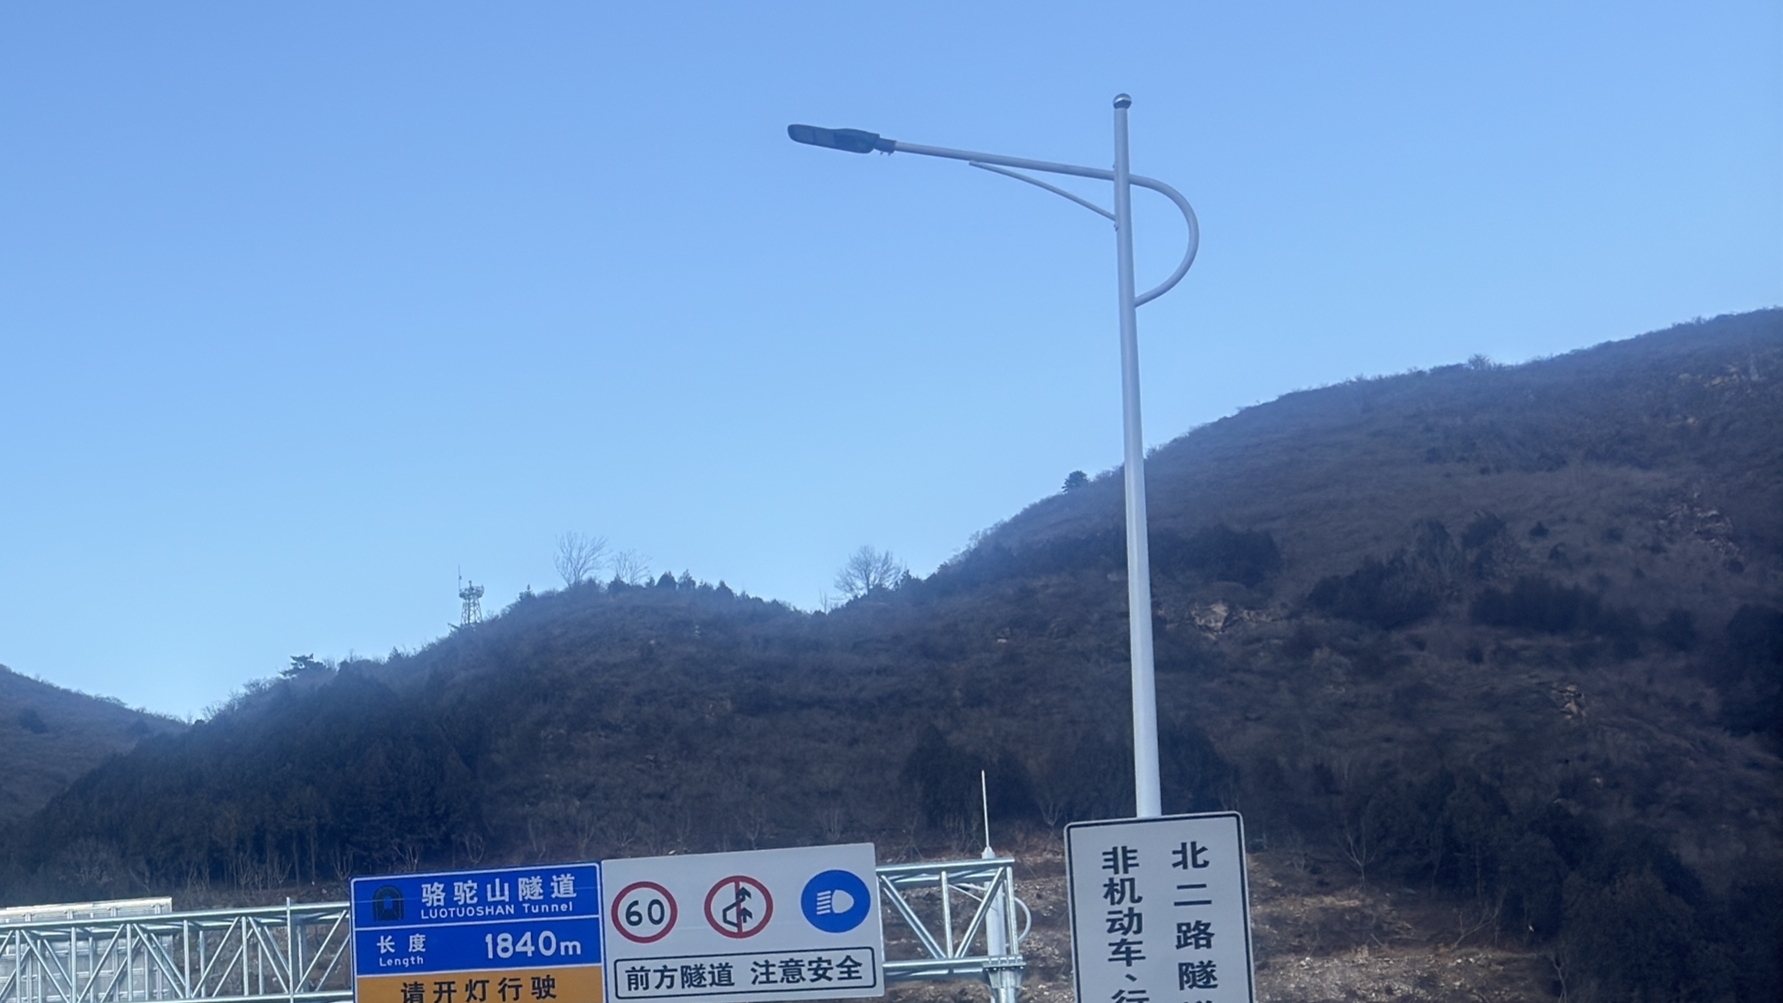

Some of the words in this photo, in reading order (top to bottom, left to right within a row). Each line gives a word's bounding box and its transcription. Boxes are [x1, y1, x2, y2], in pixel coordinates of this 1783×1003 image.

[421, 873, 577, 907] 骆驼山隧道
[421, 904, 515, 919] LUOTUOSHAN
[522, 901, 574, 914] Tunnel
[625, 898, 665, 926] 60
[377, 933, 426, 954] 长度
[485, 930, 582, 960] 1840m
[379, 955, 424, 968] Length
[625, 962, 735, 991] 前方隧道
[750, 954, 863, 985] 注意安全
